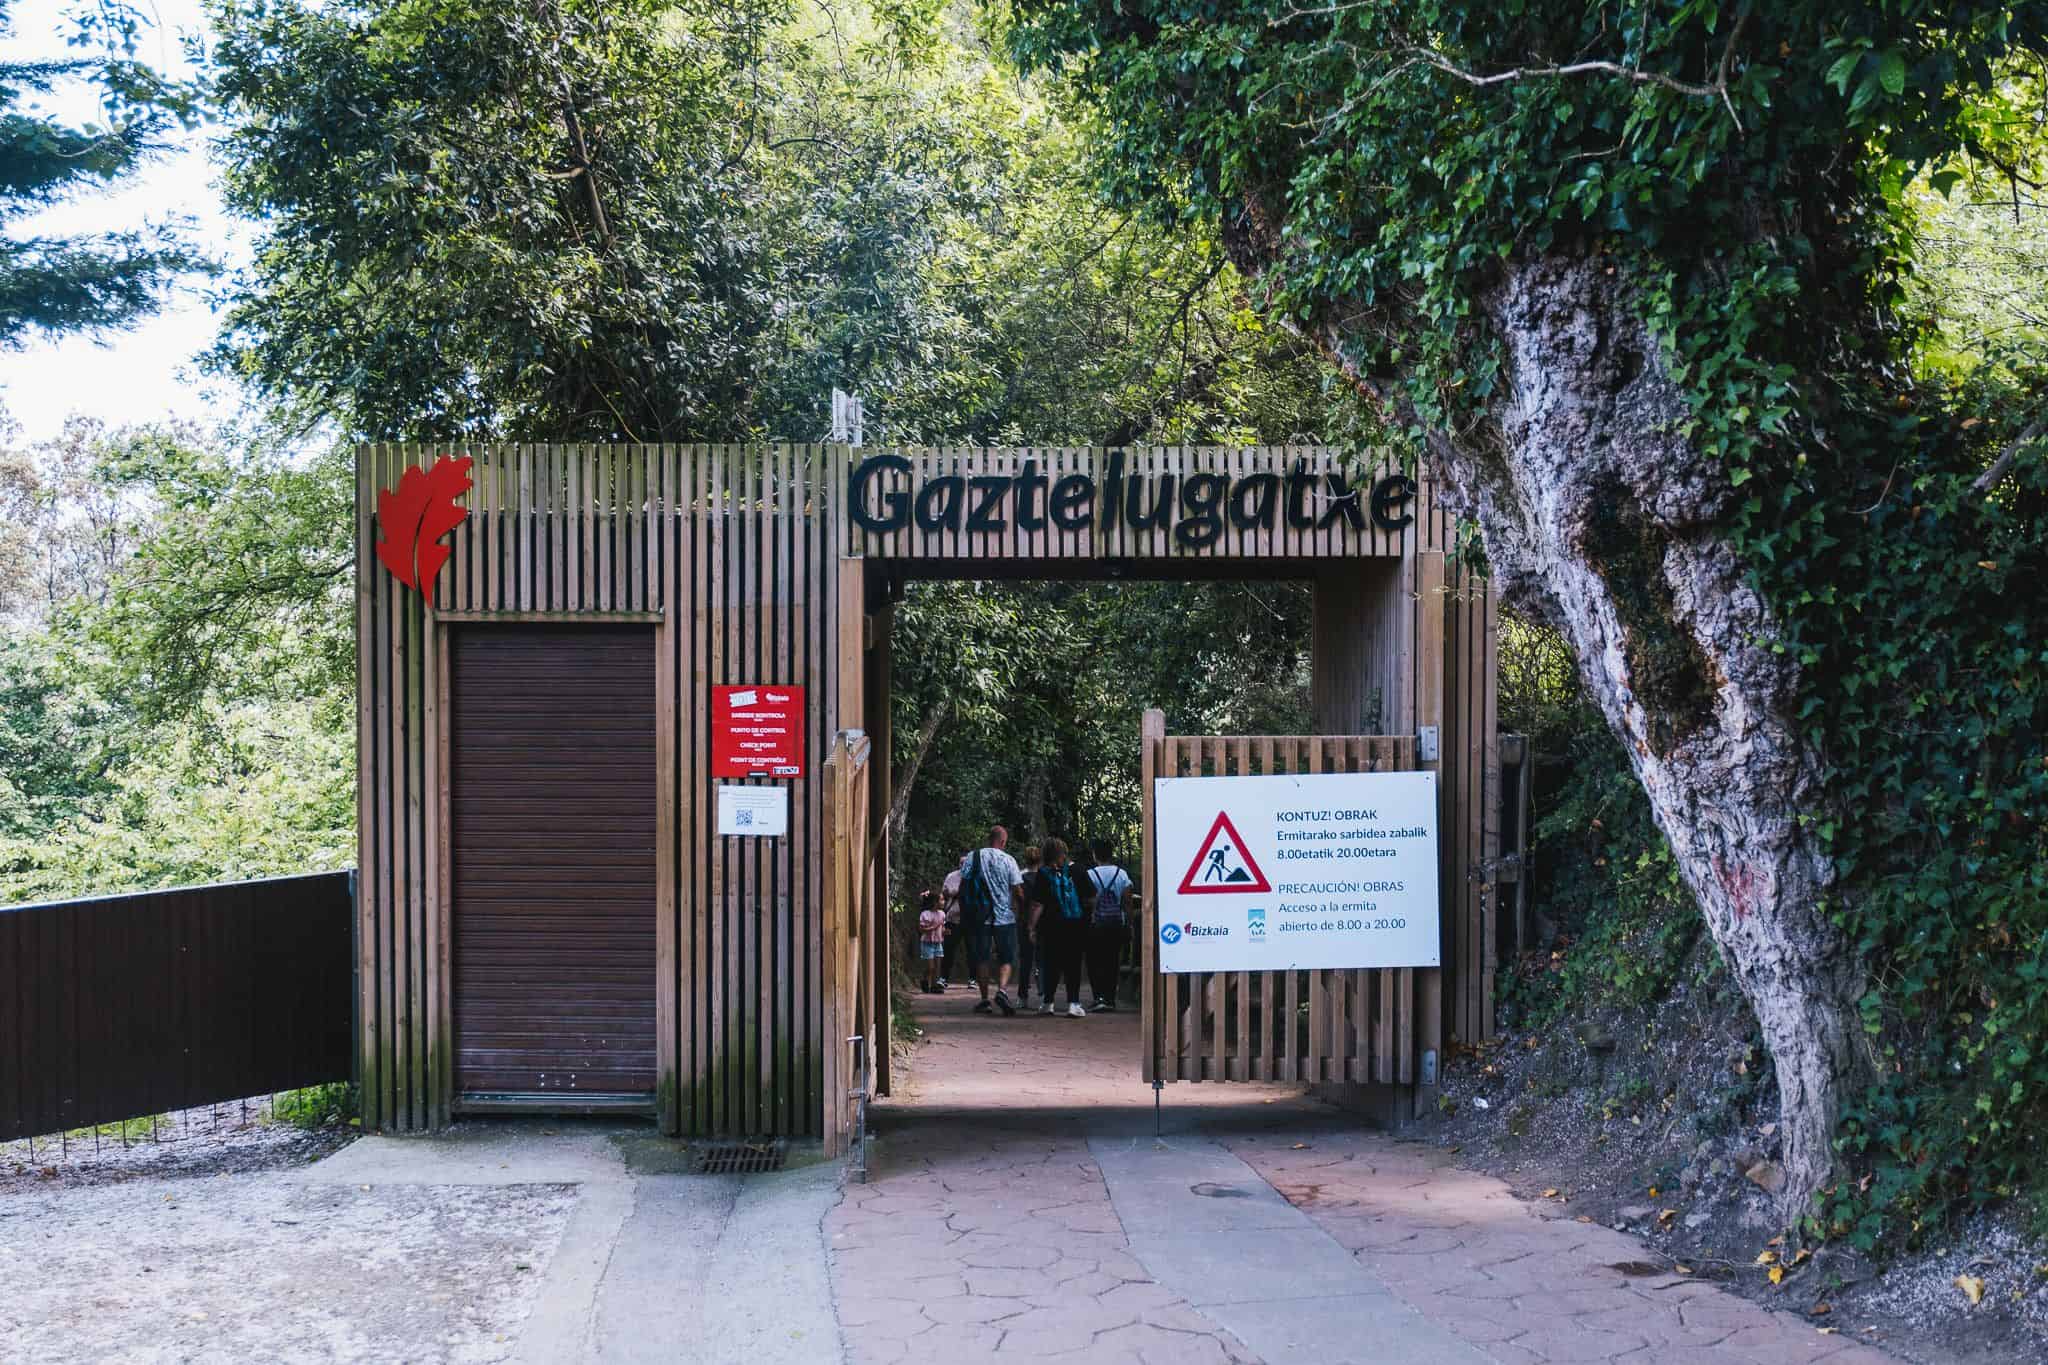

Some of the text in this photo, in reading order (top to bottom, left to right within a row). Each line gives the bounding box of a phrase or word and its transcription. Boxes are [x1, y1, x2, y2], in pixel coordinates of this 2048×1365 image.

[851, 451, 1417, 548] Gaztelugatxe
[1277, 809, 1378, 823] KONTUZ! OBRAK
[1277, 826, 1427, 841] Ermitarako sarbidea zabalik
[1277, 848, 1396, 860] 8.00etatik 20.00etara
[1279, 881, 1404, 895] PRECAUCIÓN! OBRAS
[1278, 901, 1376, 912] Acceso a la ermita
[1279, 918, 1406, 932] abierto de 8.00 a 20.00
